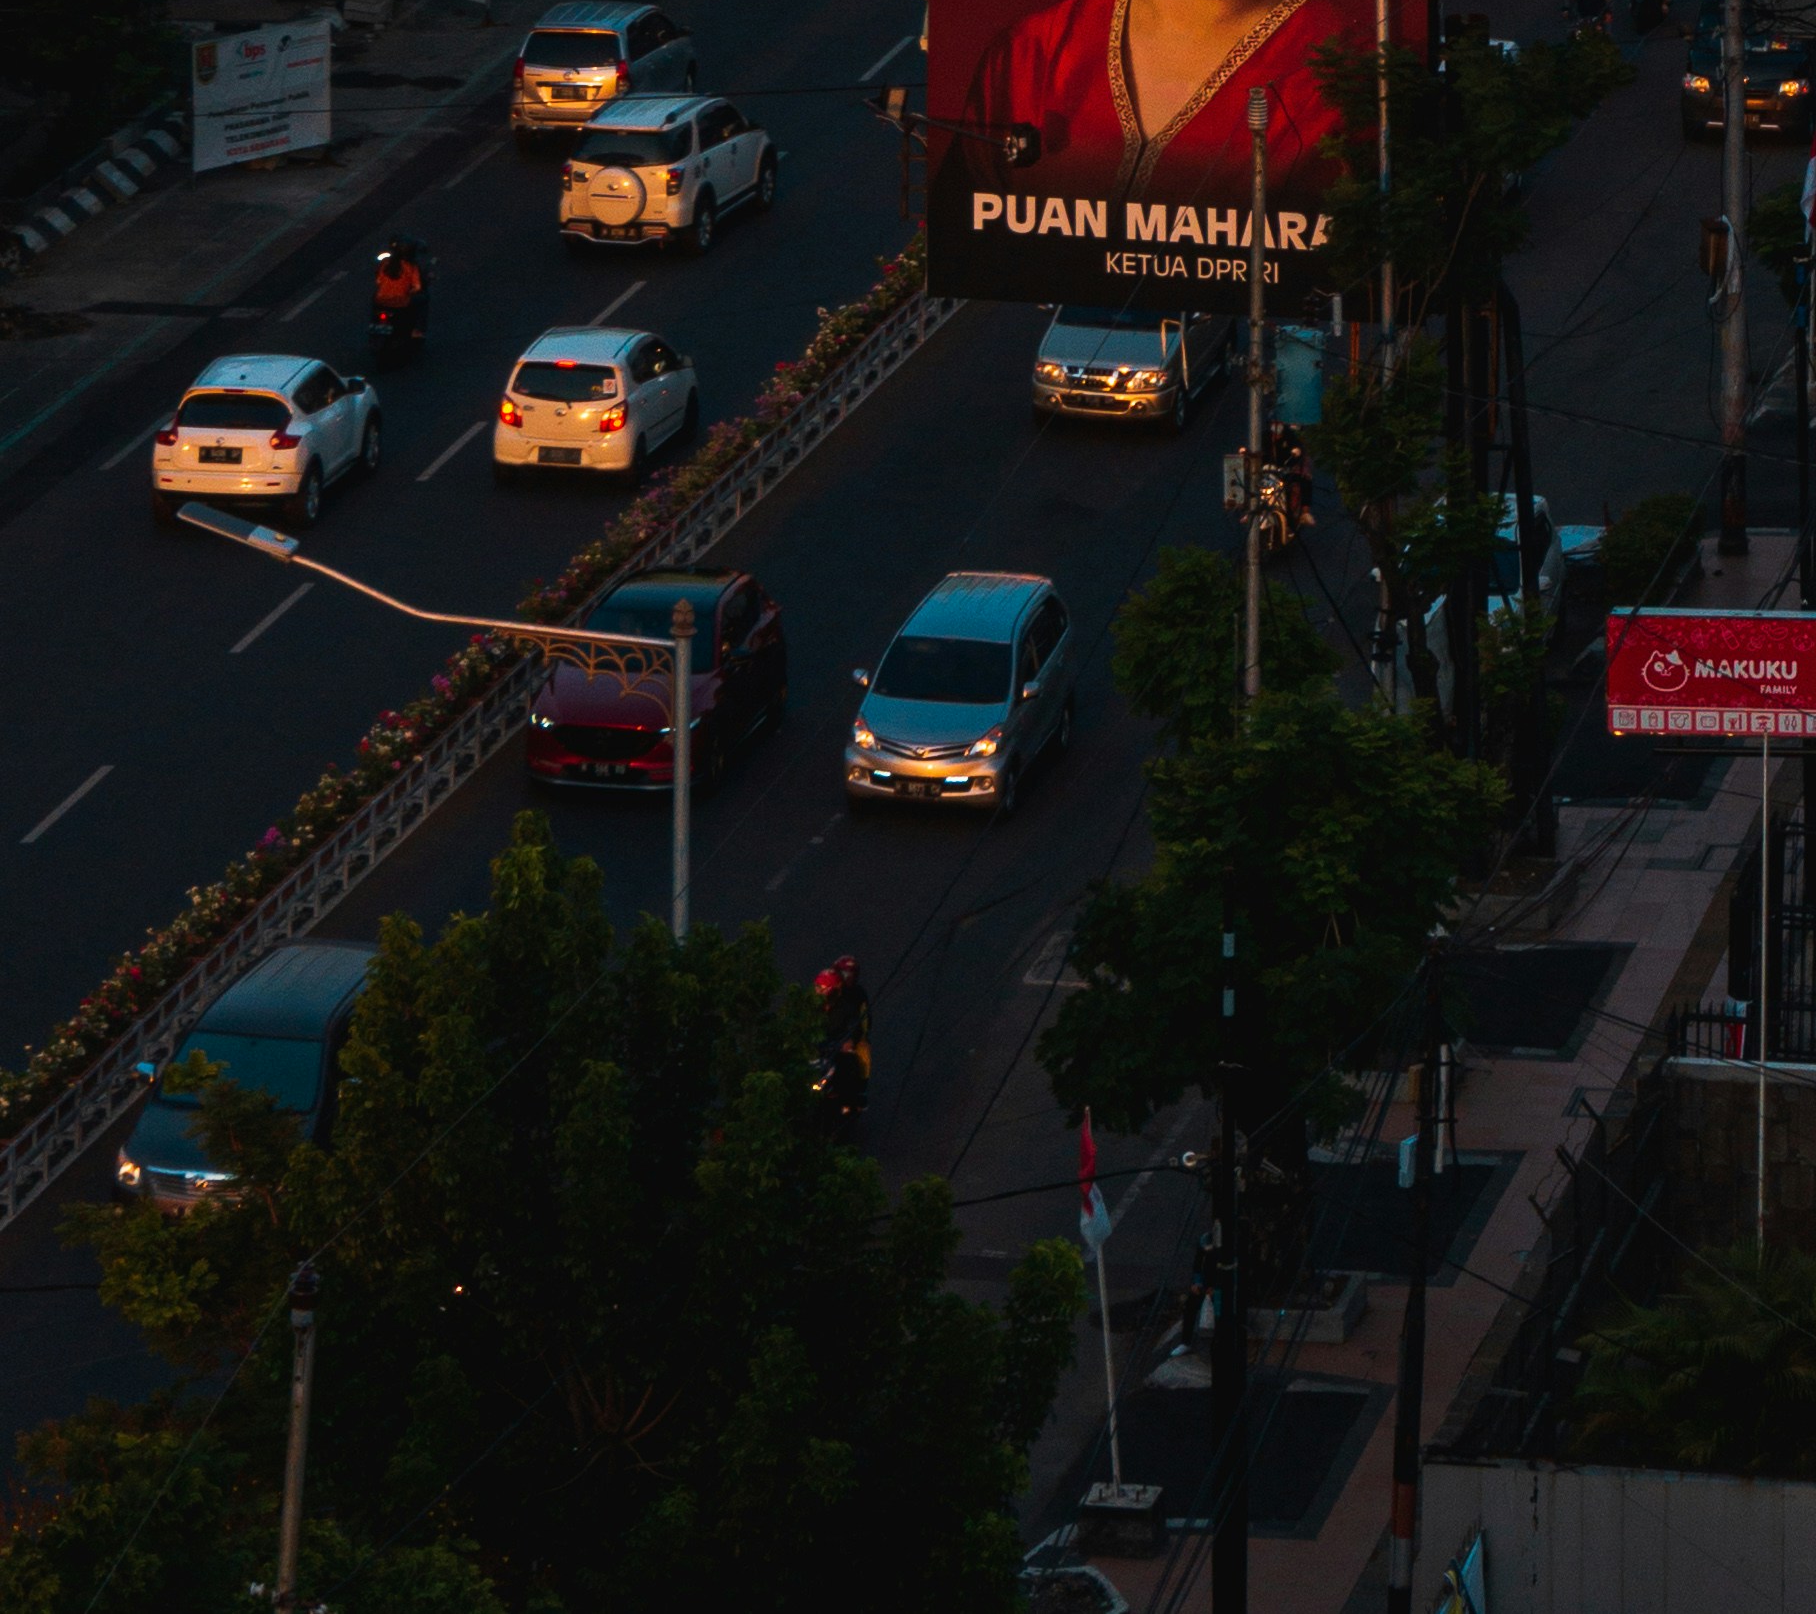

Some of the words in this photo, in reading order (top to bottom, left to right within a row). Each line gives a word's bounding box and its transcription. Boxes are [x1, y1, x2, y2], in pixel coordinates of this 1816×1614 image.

[973, 192, 1107, 238] PUAN
[1125, 202, 1334, 251] MAHARA
[1106, 251, 1188, 279] KETUA
[1197, 257, 1247, 282] DPR
[1694, 658, 1798, 680] MAKUKU
[1760, 684, 1798, 695] FAMILY
